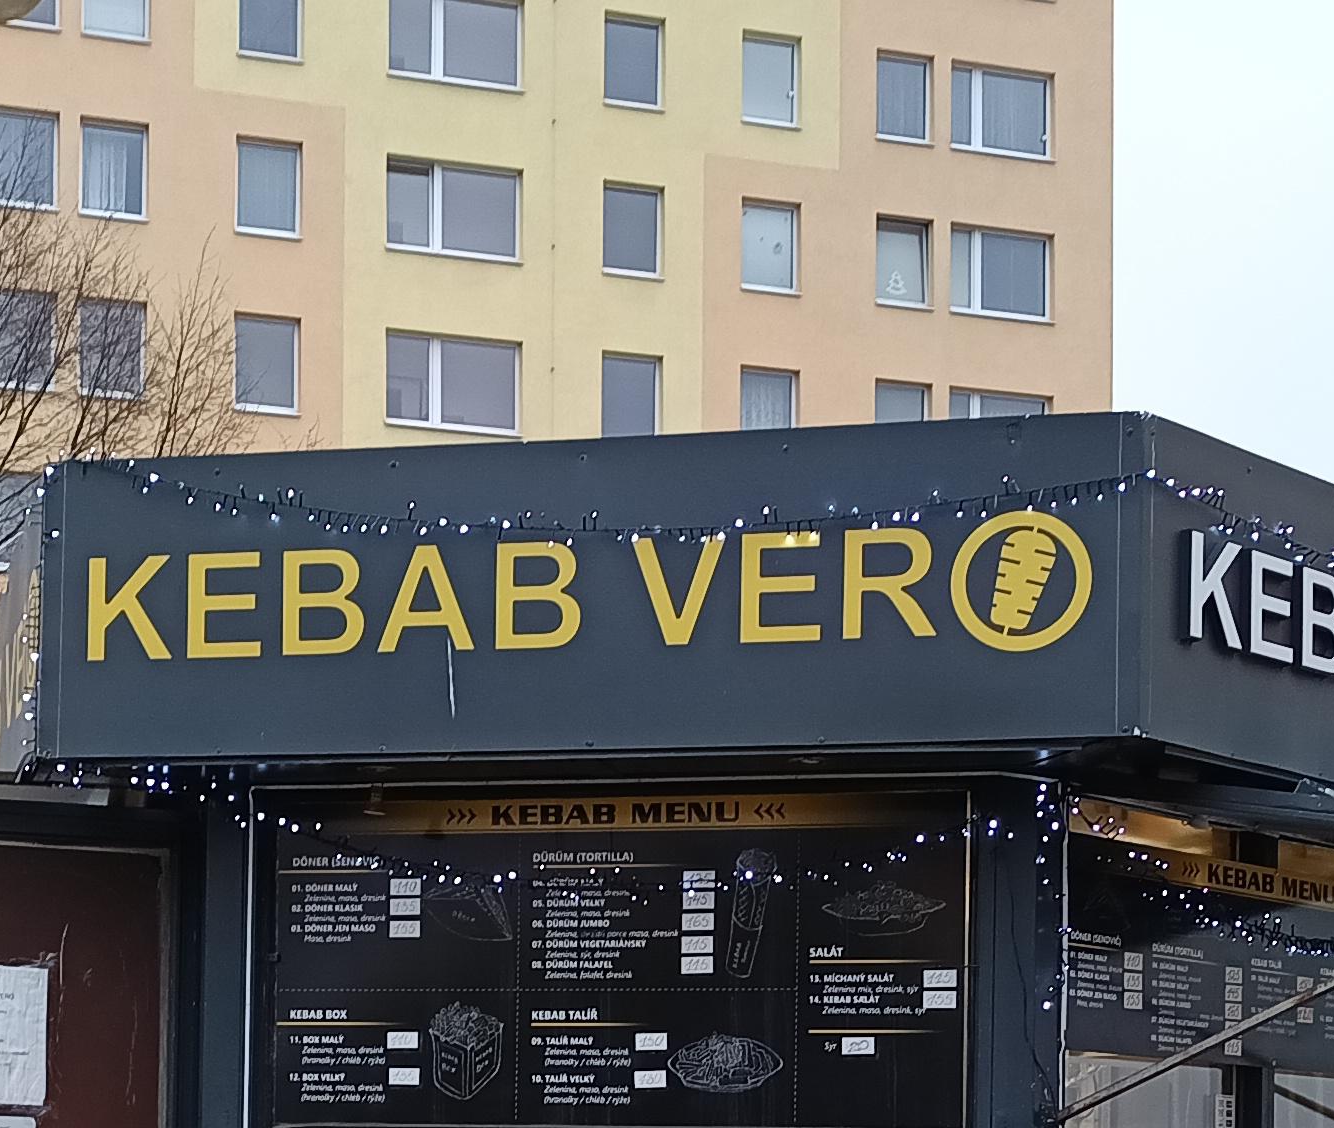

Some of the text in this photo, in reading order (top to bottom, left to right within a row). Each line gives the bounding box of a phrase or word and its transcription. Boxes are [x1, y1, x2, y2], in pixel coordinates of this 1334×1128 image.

[86, 510, 1093, 661] KEBAB VERO
[492, 801, 740, 825] KEBAB MENU
[292, 856, 328, 867] DÖNER
[533, 851, 634, 863] DÜRÜM (TORTILLA)
[305, 882, 333, 892] DÖNER
[335, 882, 359, 892] MALÝ
[394, 881, 417, 893] 110
[1207, 863, 1334, 904] KEBAB MENU
[304, 903, 333, 912] DÖNER
[334, 903, 364, 912] KLASIK
[532, 899, 544, 907] 05.
[547, 898, 578, 907] DÜRÜM
[531, 919, 610, 928] 06. DÜRÜM JUMBO
[685, 915, 709, 928] 165
[304, 923, 333, 932] DÖNER
[334, 923, 349, 932] JEN
[350, 923, 376, 932] MASO
[531, 940, 544, 949] 07.
[546, 939, 577, 948] DÜRÜM
[808, 944, 844, 957] SALÁT
[546, 959, 577, 969] DÜRÜM
[580, 960, 613, 969] FALAFEL
[823, 973, 866, 983] MÍCHANÝ
[868, 972, 894, 982] SALÁT
[809, 994, 880, 1004] 14. KEBAB SALÁT
[289, 1009, 347, 1020] KEBAB BOX
[531, 1008, 598, 1020] KEBAB TALÍŘ
[289, 1034, 344, 1044] 11. BOX MALÝ
[531, 1035, 593, 1045] 09. TALÍŘ MALÝ
[824, 1042, 837, 1052] Sýr
[847, 1039, 870, 1053] 20
[289, 1072, 345, 1081] 12. BOX VELKÝ
[531, 1073, 595, 1083] 10. TALÍŘ VELKÝ
